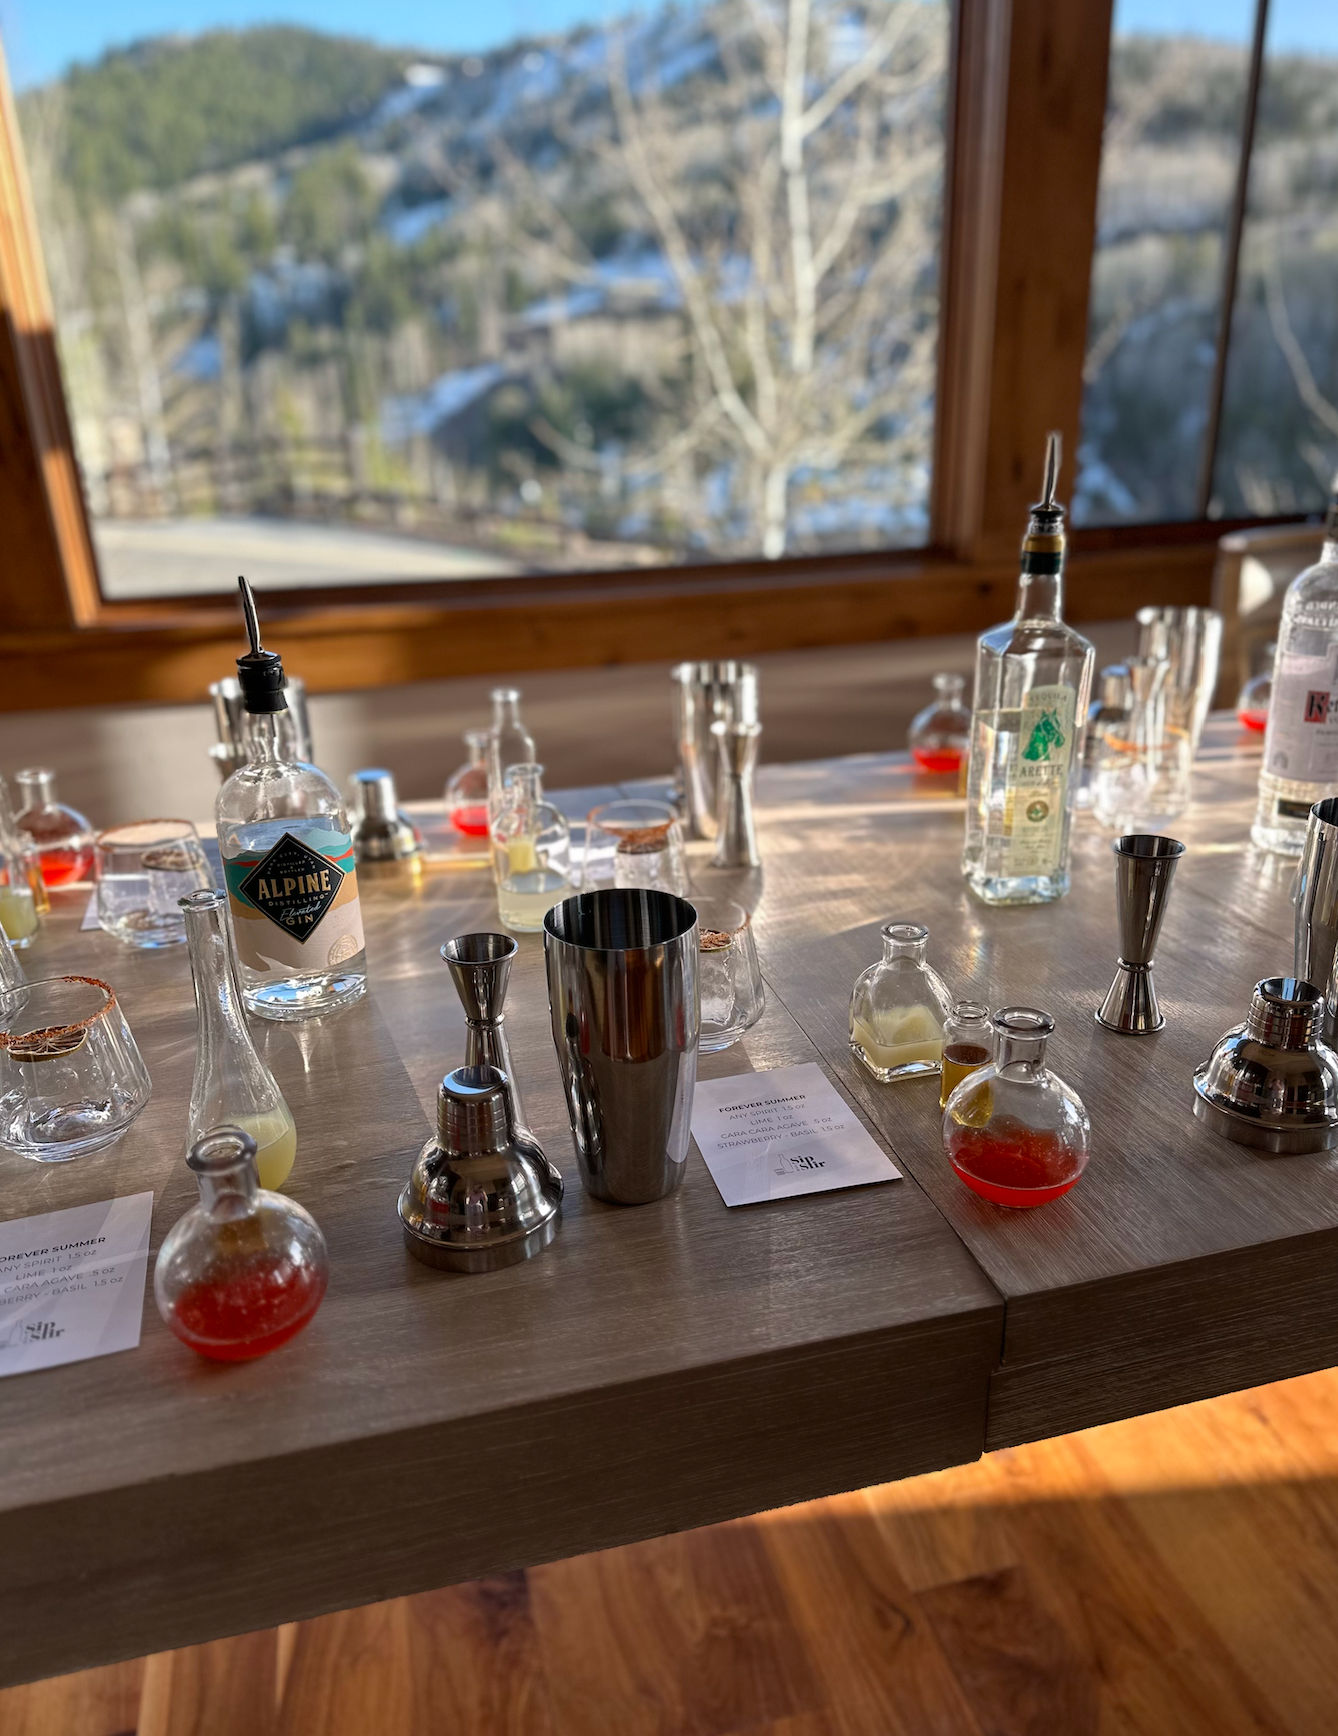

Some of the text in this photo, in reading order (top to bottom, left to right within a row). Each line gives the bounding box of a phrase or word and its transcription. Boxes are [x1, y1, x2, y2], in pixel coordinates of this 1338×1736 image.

[1019, 764, 1064, 778] ARETTE
[258, 869, 331, 900] ALPINE
[281, 901, 321, 921] Elevated
[286, 914, 314, 926] GIN
[719, 1095, 806, 1112] FOREVER SUMMER
[729, 1112, 748, 1121] ANY
[750, 1108, 778, 1117] SPIRIT
[750, 1117, 774, 1126] LIME
[717, 1134, 783, 1150] STRAWBERRY
[790, 1128, 818, 1138] BASIL
[720, 1130, 748, 1140] CARA
[748, 1126, 776, 1135] CARA
[776, 1120, 809, 1130] AGAVE
[52, 1237, 106, 1253] SUMMER
[23, 1255, 62, 1269] SPIRIT
[84, 1249, 97, 1257] oz
[4, 1281, 40, 1294] CARA
[40, 1273, 84, 1289] AGAVE
[101, 1267, 115, 1275] oz
[15, 1269, 46, 1281] LIME
[59, 1264, 72, 1272] oz
[51, 1284, 88, 1296] BASIL
[109, 1276, 124, 1284] oz
